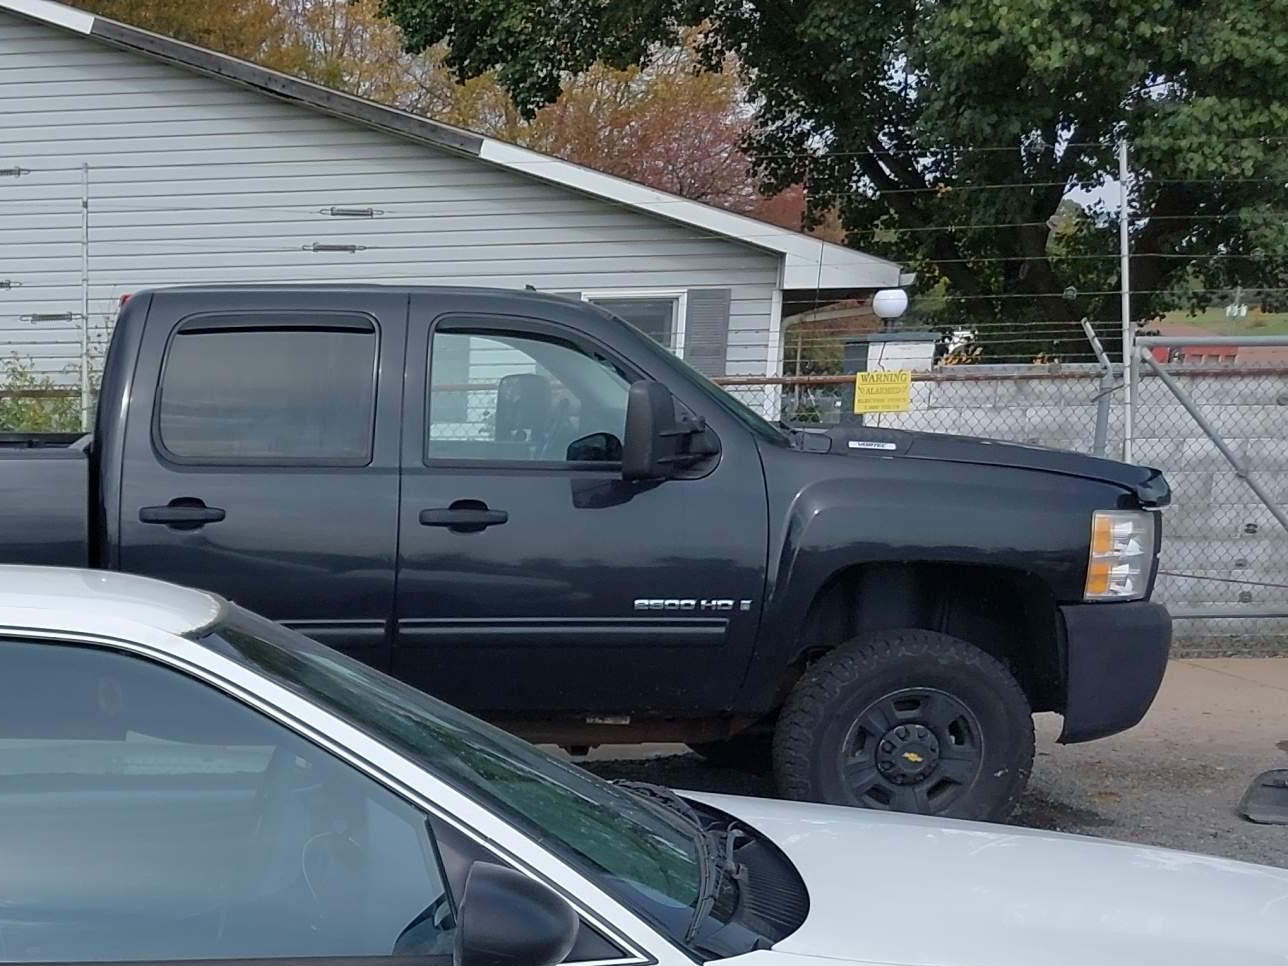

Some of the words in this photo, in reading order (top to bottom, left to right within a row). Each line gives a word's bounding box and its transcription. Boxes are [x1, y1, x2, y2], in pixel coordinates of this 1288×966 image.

[861, 373, 907, 383] WARNING
[634, 599, 697, 611] 2500
[700, 599, 734, 611] HD
